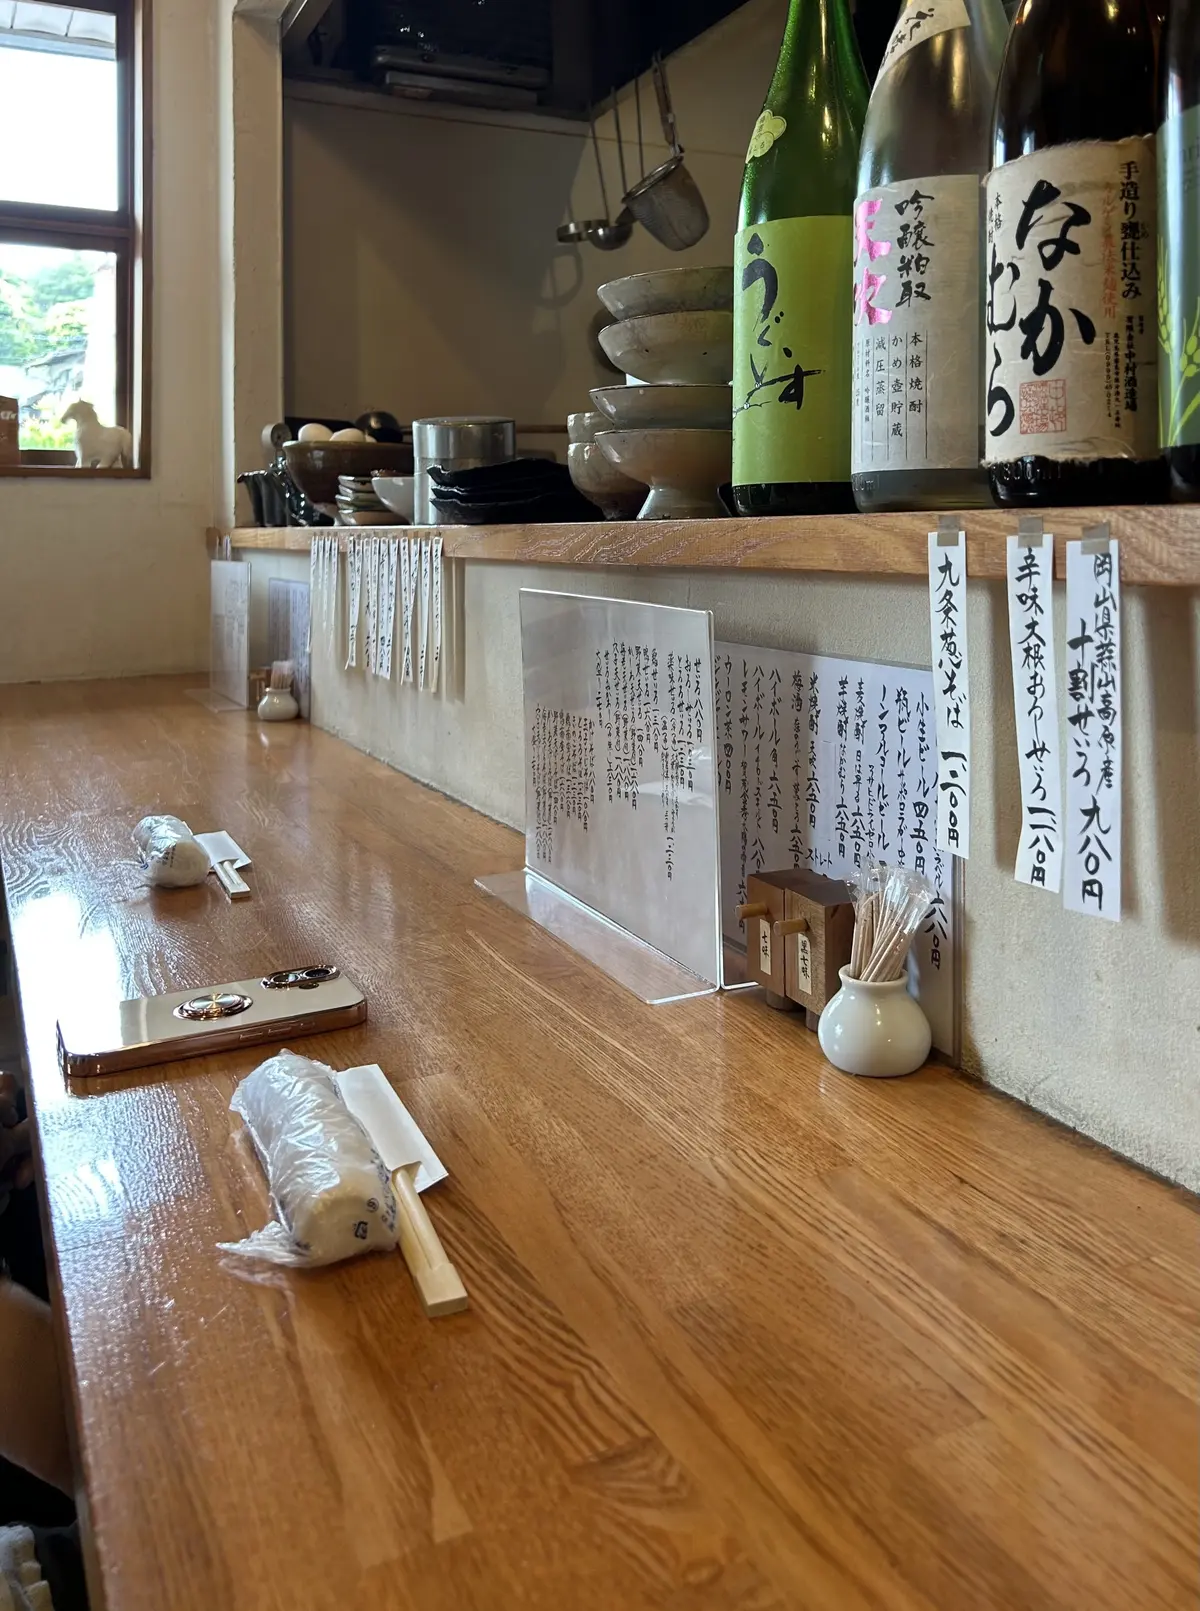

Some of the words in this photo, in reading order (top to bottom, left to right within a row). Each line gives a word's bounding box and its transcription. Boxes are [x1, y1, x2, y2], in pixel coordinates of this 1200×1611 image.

[1015, 178, 1096, 377] なか
[875, 336, 887, 417] 減圧蒸留
[890, 335, 904, 438] かめ壺貯蔵
[909, 331, 924, 414] 本格焼酎
[987, 243, 1021, 437] むら
[934, 552, 967, 729] 九条葱そば
[805, 848, 833, 867] ストレート
